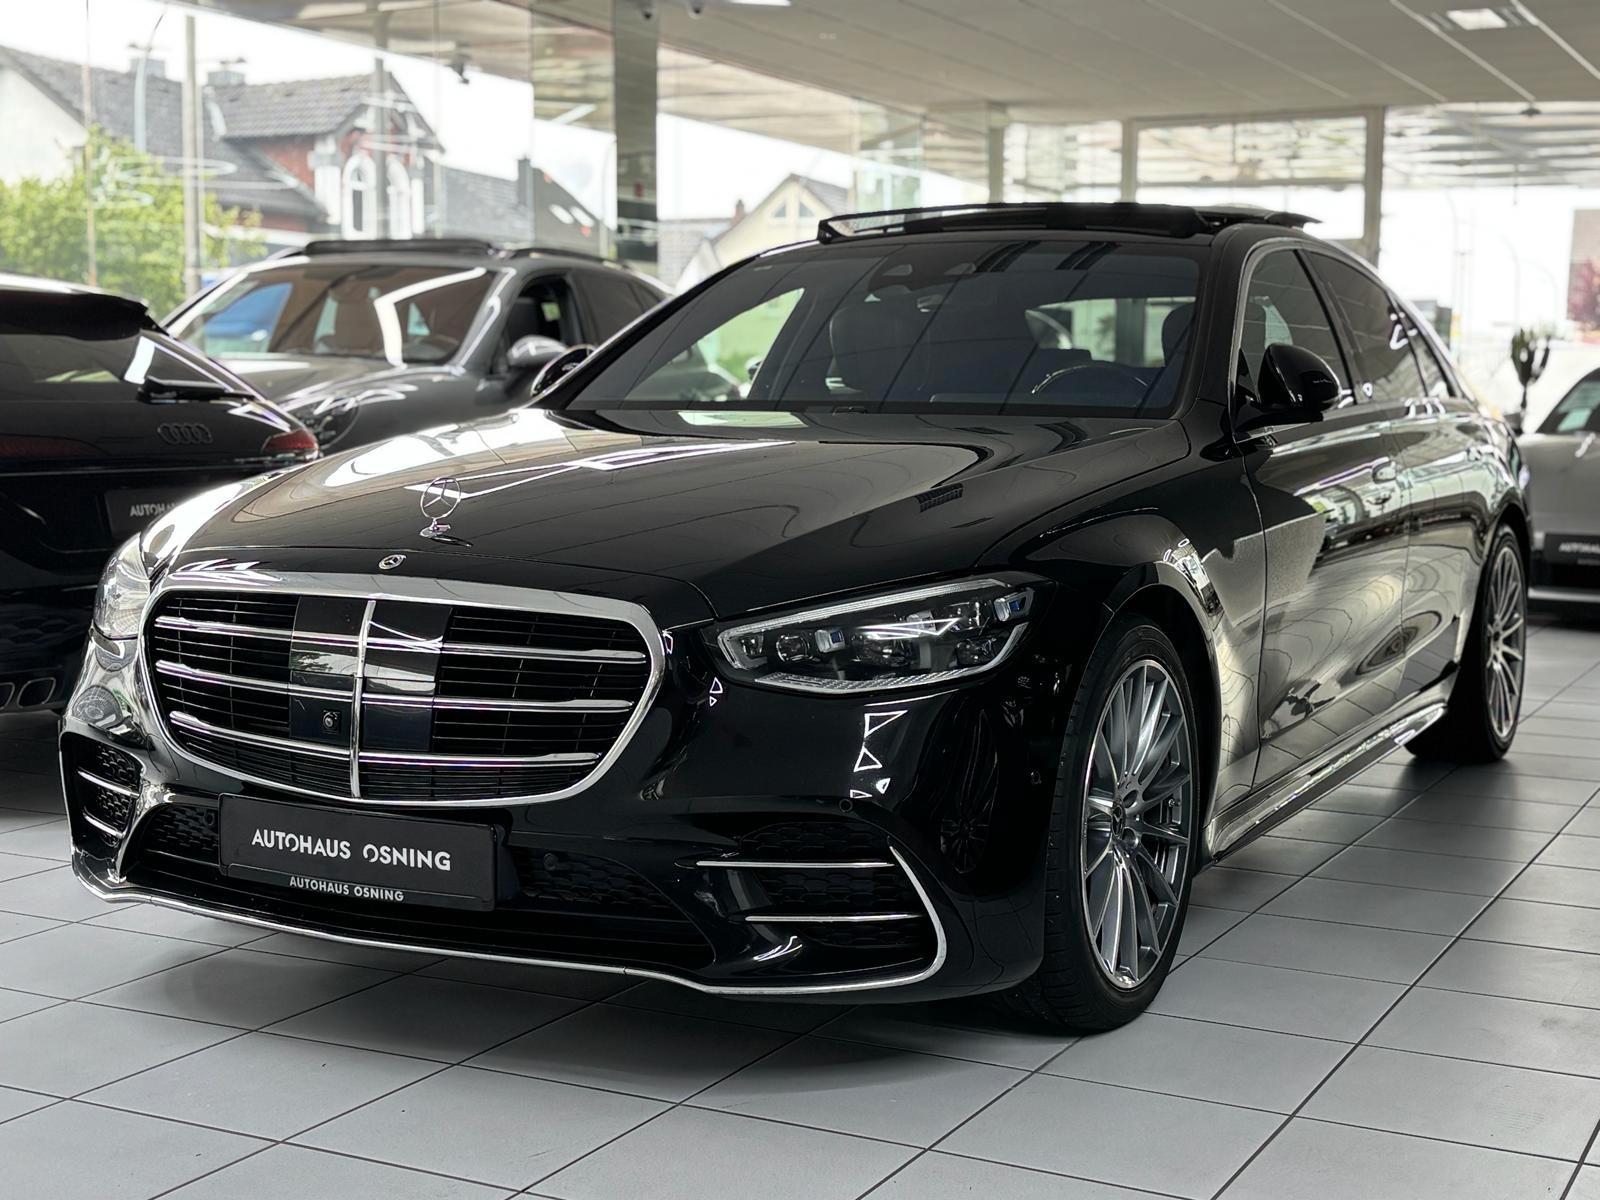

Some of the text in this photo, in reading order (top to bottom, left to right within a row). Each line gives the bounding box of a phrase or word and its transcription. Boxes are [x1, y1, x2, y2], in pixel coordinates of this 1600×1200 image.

[251, 829, 451, 872] AUTOHAUS OSNING
[289, 876, 404, 902] AUTOHAUS OSNING
